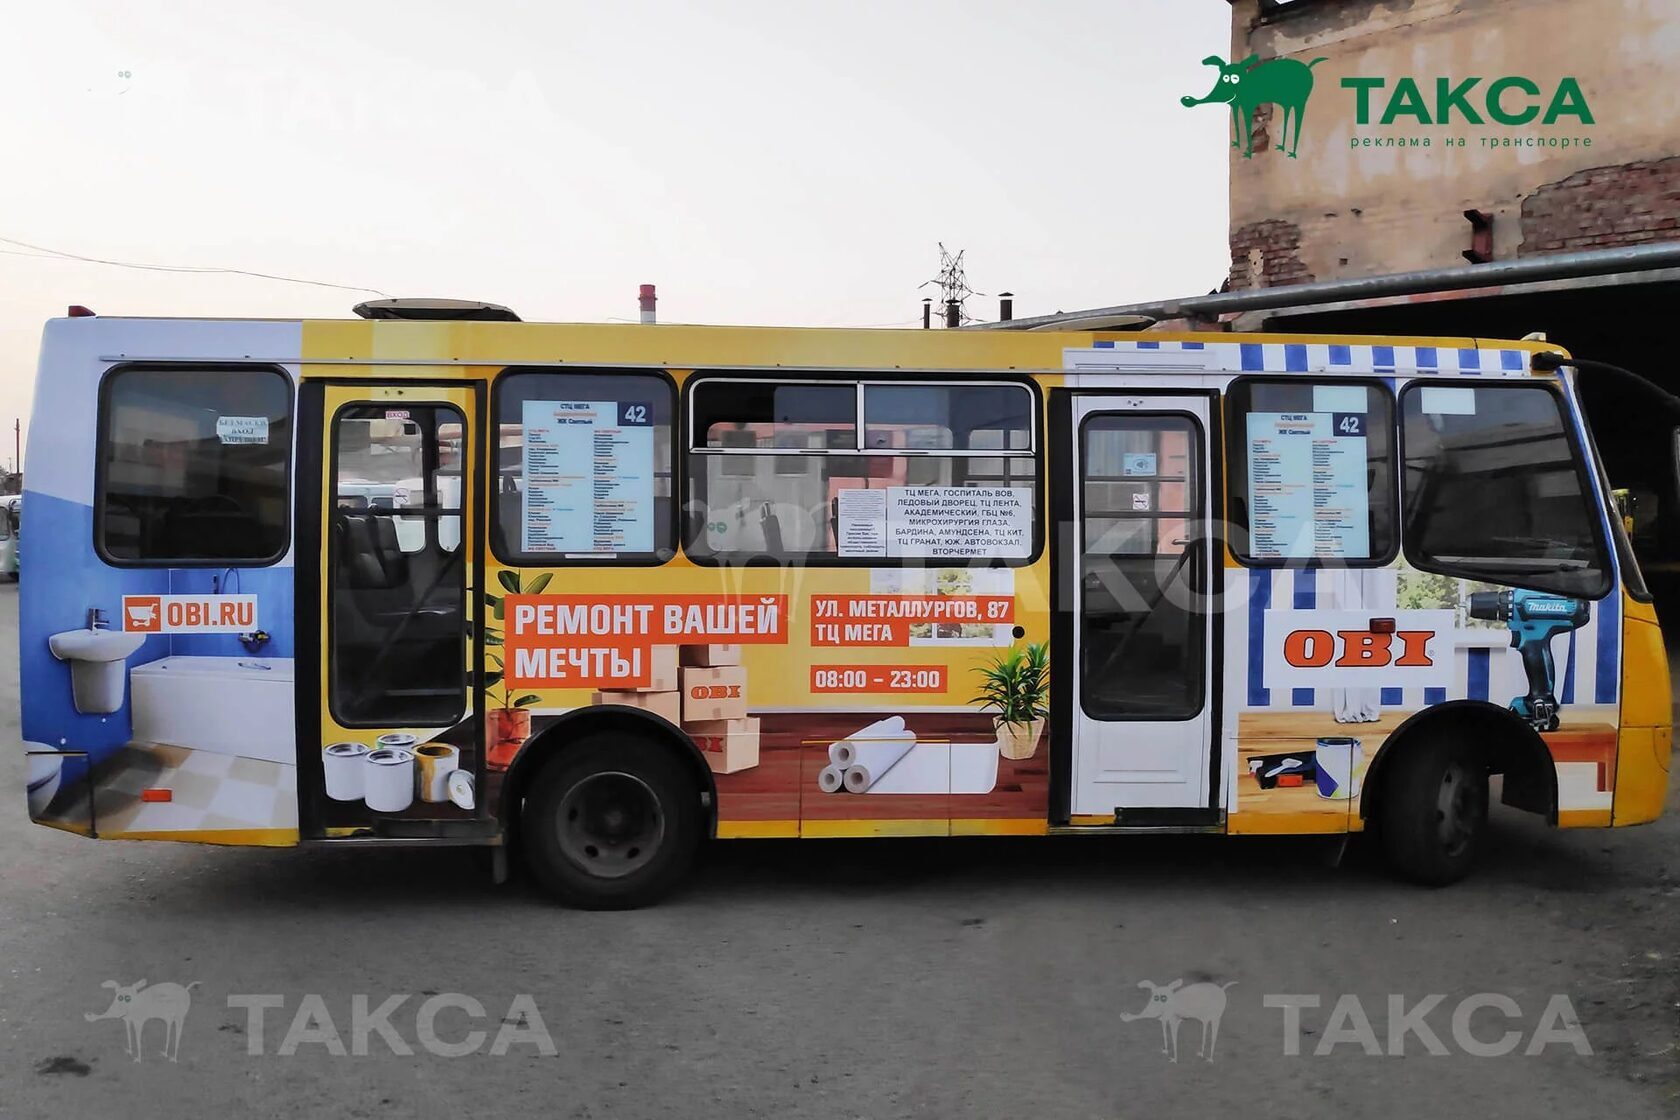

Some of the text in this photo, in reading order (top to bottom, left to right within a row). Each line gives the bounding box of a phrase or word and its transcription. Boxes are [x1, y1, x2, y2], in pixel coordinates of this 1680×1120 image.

[625, 406, 646, 423] 42
[1340, 416, 1360, 433] 42
[905, 490, 1015, 498] ТЦ МЕГА, ГОСПИТАЛЬ ВОВ,
[897, 499, 1021, 507] ЛЕДОВЫЙ ДВОРЕЦ, ТЦ ЛЕНТА,
[904, 509, 980, 517] АКАДЕМИЧЕСКИЙ,
[909, 519, 980, 527] МИКРОХИРУРГИЯ
[895, 529, 936, 537] БАРДИНА,
[938, 529, 991, 537] АМУНДСЕНА,
[994, 529, 1005, 537] ТЦ
[897, 538, 908, 546] ТЦ
[910, 538, 943, 546] ГРАНАТ,
[932, 548, 987, 556] ВТОРЧЕРМЕТ
[167, 601, 253, 628] OBI.RU
[515, 597, 778, 634] РЕМОНТ ВАШЕЙ
[815, 600, 1009, 620] УЛ. МЕТАЛЛУРГОВ, 87
[815, 624, 893, 643] ТЦ МЕГА
[1284, 629, 1435, 667] OBI
[515, 648, 641, 678] МЕЧТЫ
[815, 670, 866, 688] 08:00
[890, 670, 940, 688] 23:00
[690, 685, 741, 699] OBI
